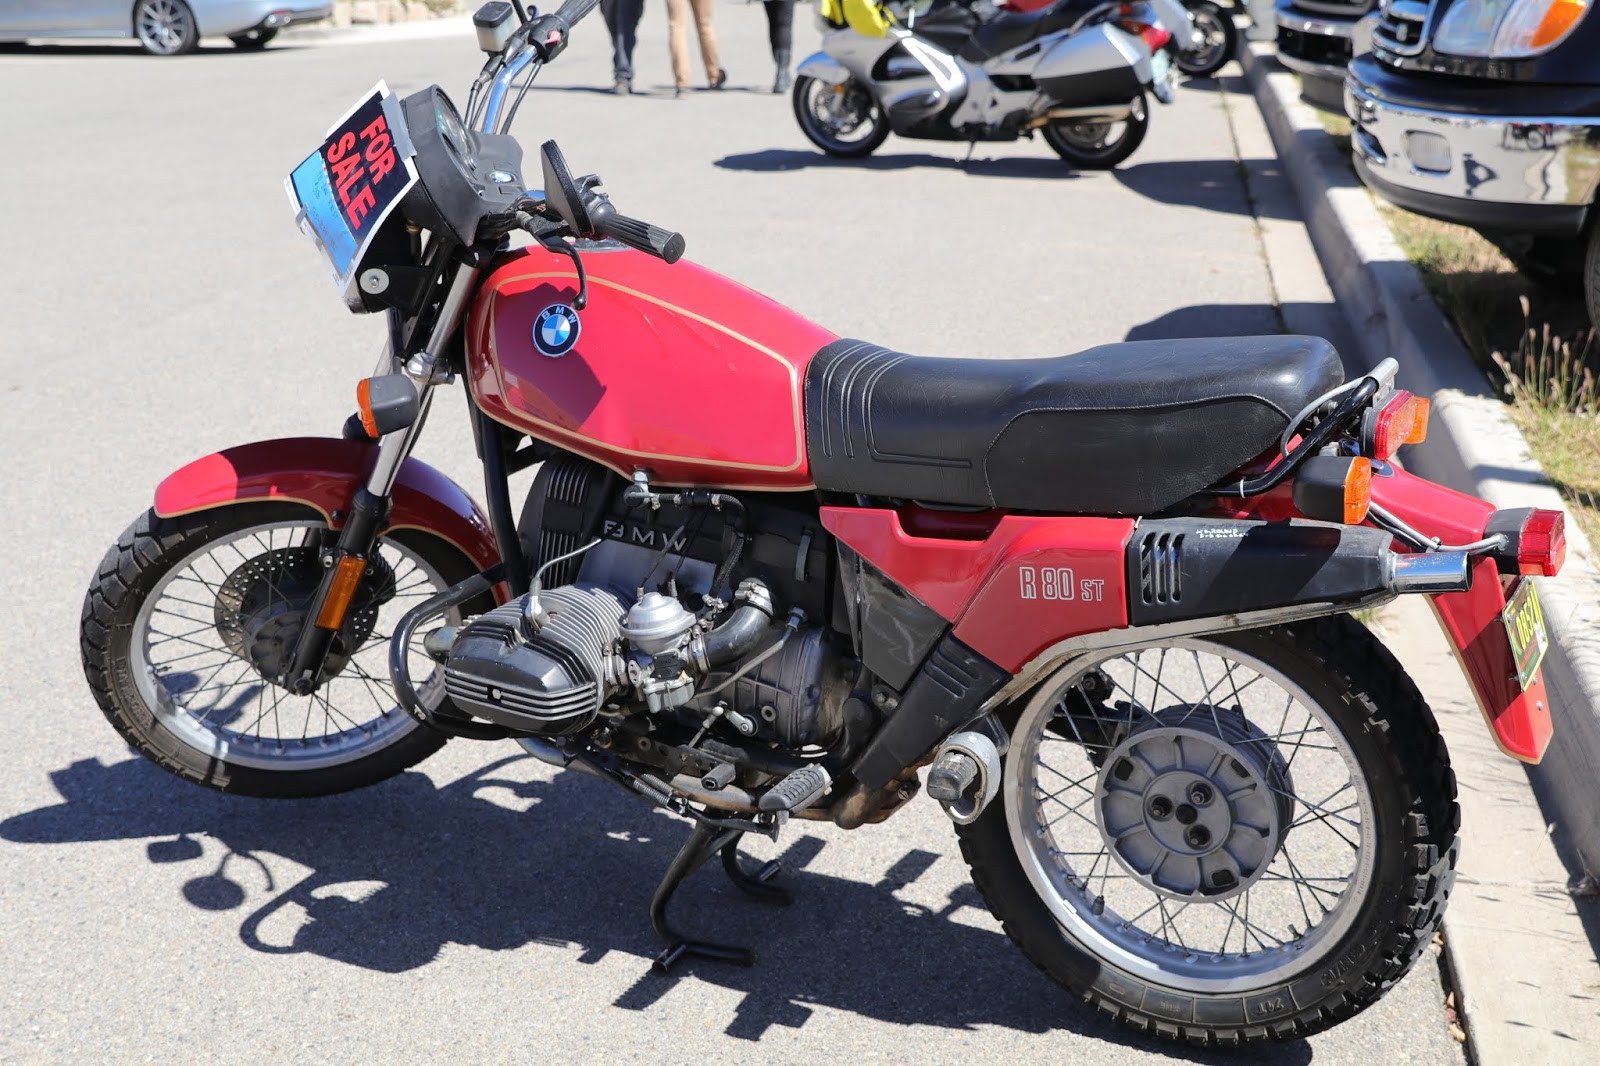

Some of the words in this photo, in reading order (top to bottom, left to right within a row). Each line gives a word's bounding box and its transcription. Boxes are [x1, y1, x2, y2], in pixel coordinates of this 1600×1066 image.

[360, 115, 395, 185] FOR
[327, 131, 376, 230] SALE
[541, 306, 577, 324] BMW
[604, 520, 687, 551] BMW
[1019, 566, 1037, 600] R
[1041, 567, 1074, 601] 80
[1080, 579, 1105, 602] ST
